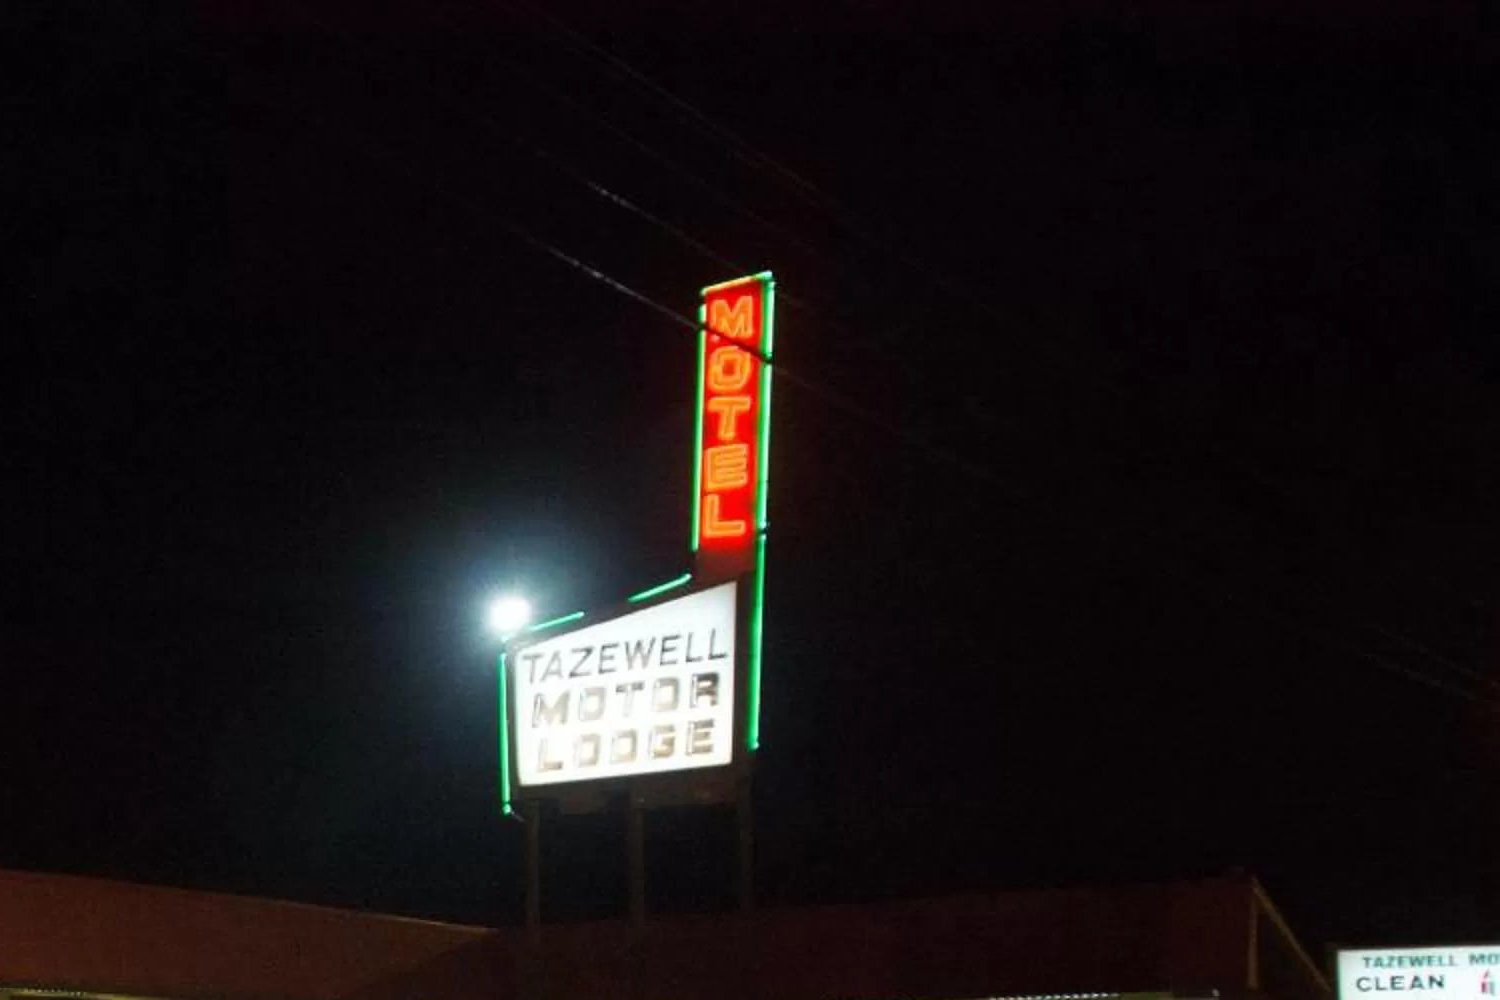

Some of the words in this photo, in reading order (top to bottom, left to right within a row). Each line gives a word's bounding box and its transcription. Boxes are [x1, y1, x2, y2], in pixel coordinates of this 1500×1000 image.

[703, 295, 755, 539] MOTEL
[522, 628, 728, 684] TAZEWELL
[531, 671, 719, 728] MOTOR
[537, 718, 714, 773] LODGE
[1355, 974, 1445, 993] CLEAN
[1361, 954, 1459, 969] TAZEWELL
